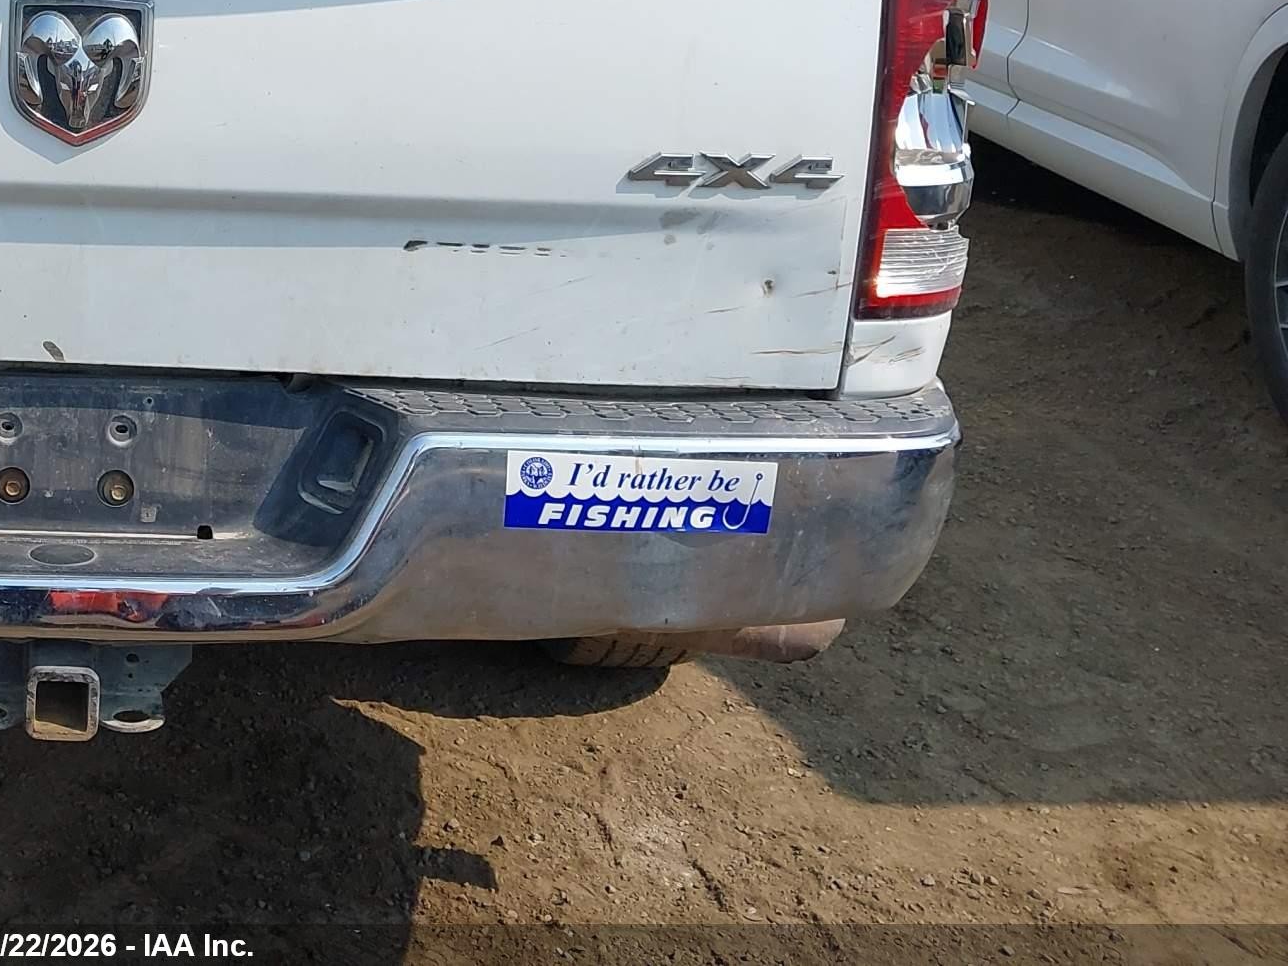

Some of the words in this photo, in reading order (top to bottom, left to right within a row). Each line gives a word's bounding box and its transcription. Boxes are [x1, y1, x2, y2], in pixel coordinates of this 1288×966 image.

[567, 462, 612, 487] I'd
[617, 467, 702, 491] rather
[708, 469, 740, 492] be
[538, 502, 716, 529] FISHING
